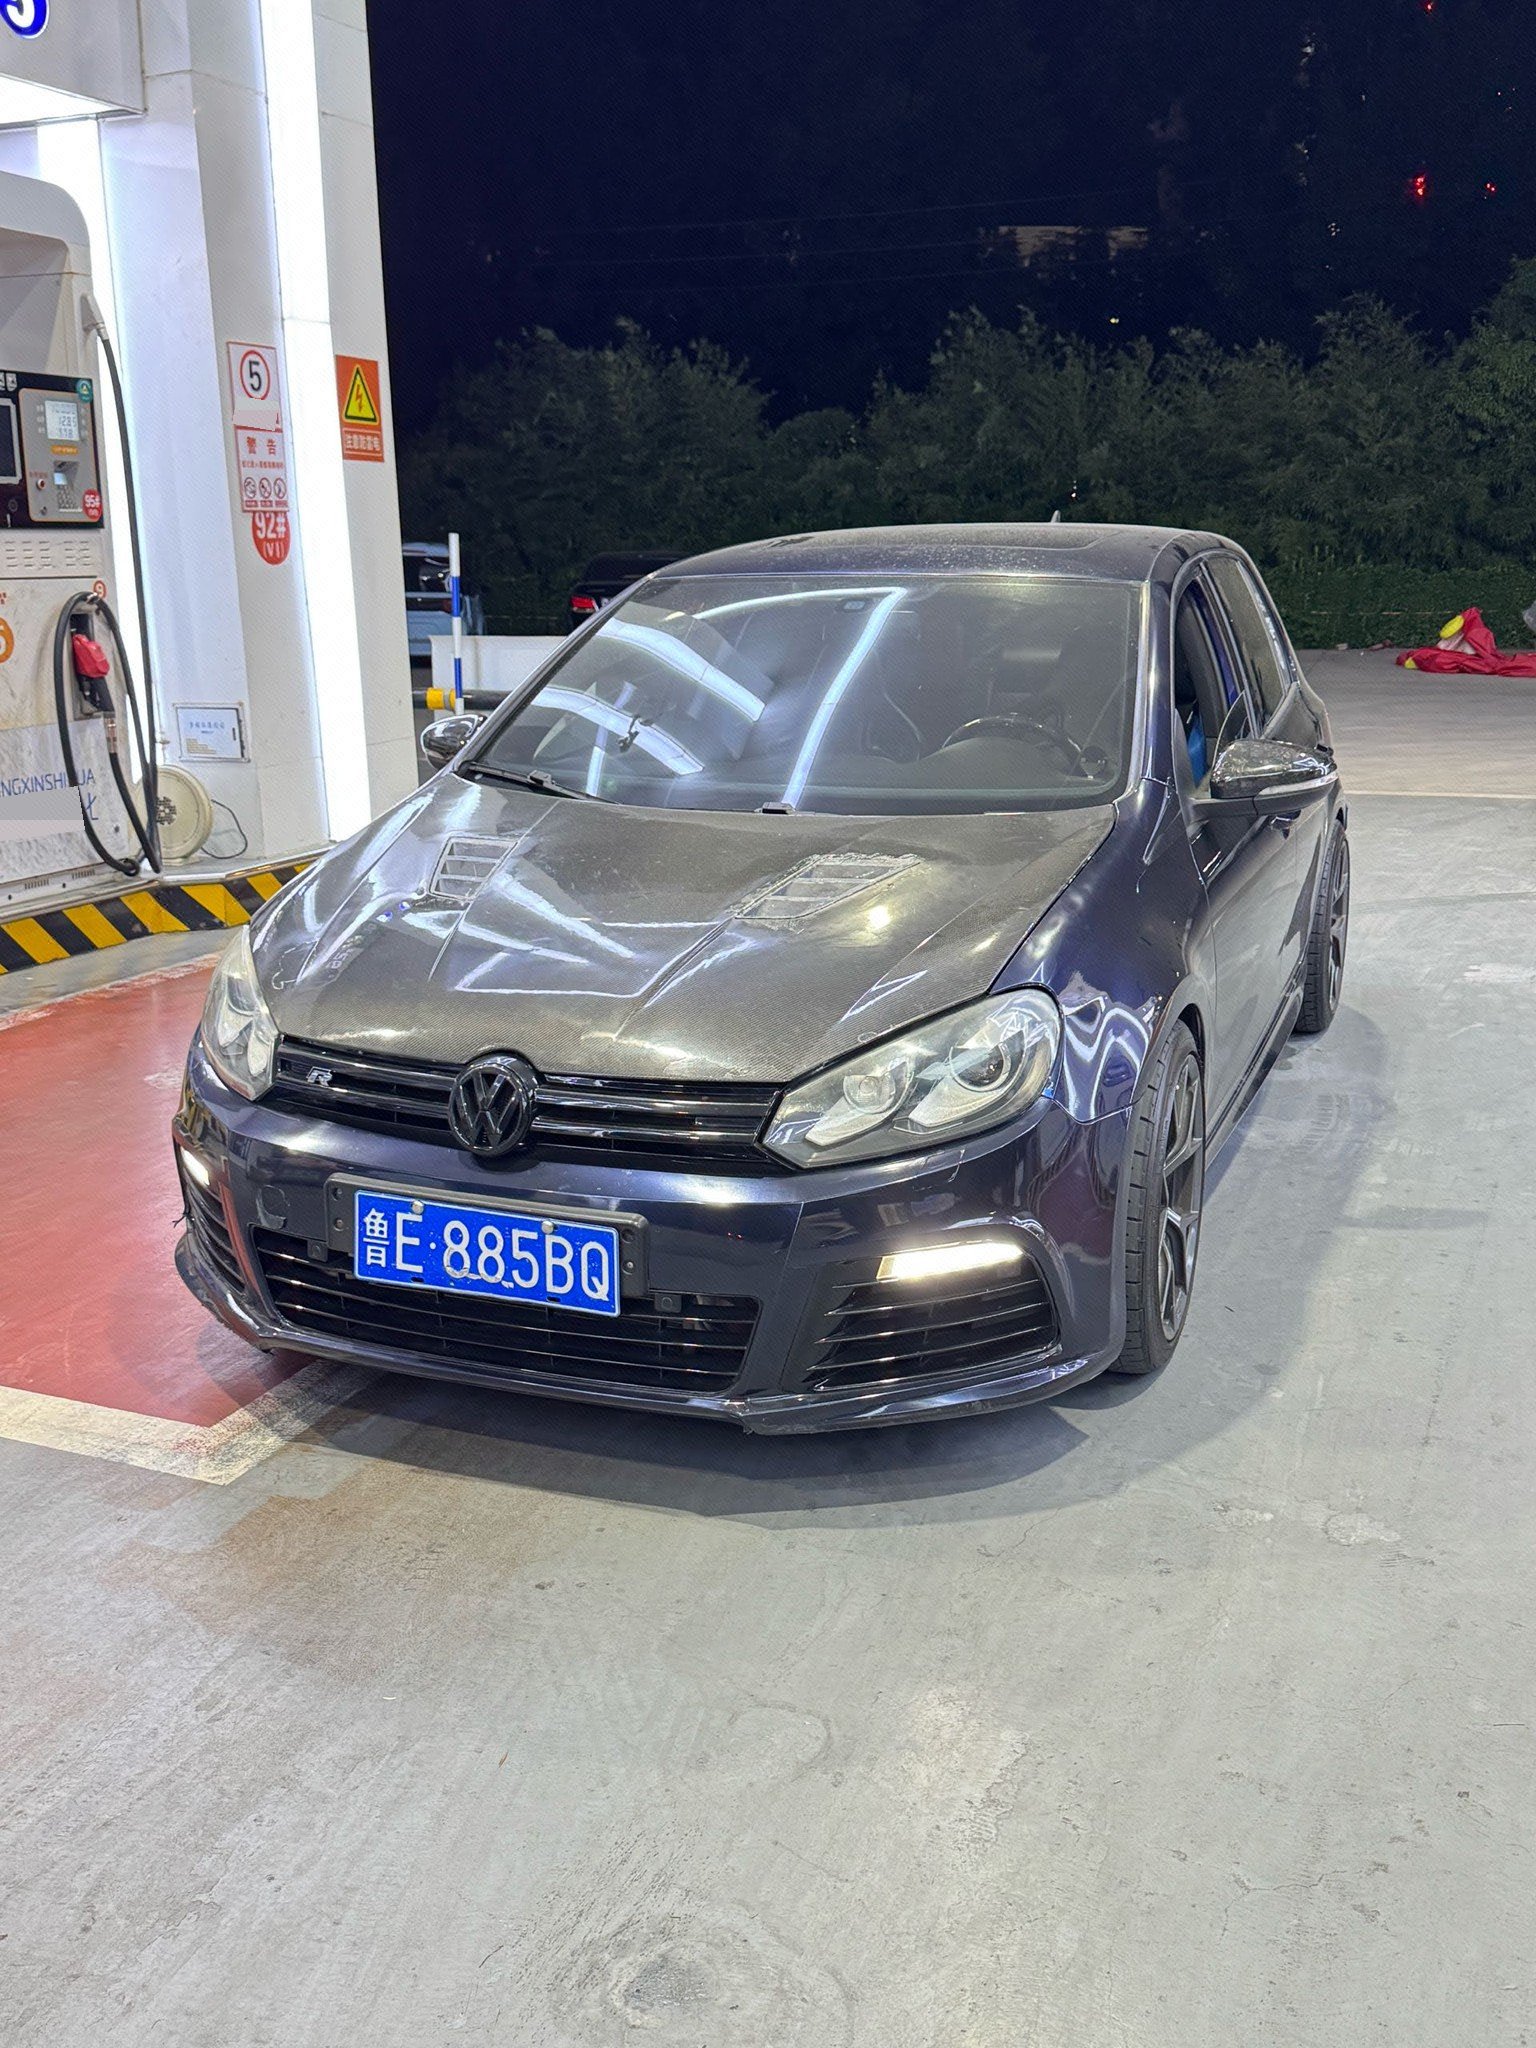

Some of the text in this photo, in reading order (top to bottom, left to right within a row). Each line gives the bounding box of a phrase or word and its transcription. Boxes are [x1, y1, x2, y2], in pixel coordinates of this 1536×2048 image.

[248, 360, 262, 392] 5
[255, 511, 286, 539] 92#
[0, 768, 96, 797] NGXINSHIUA
[305, 1066, 333, 1087] R
